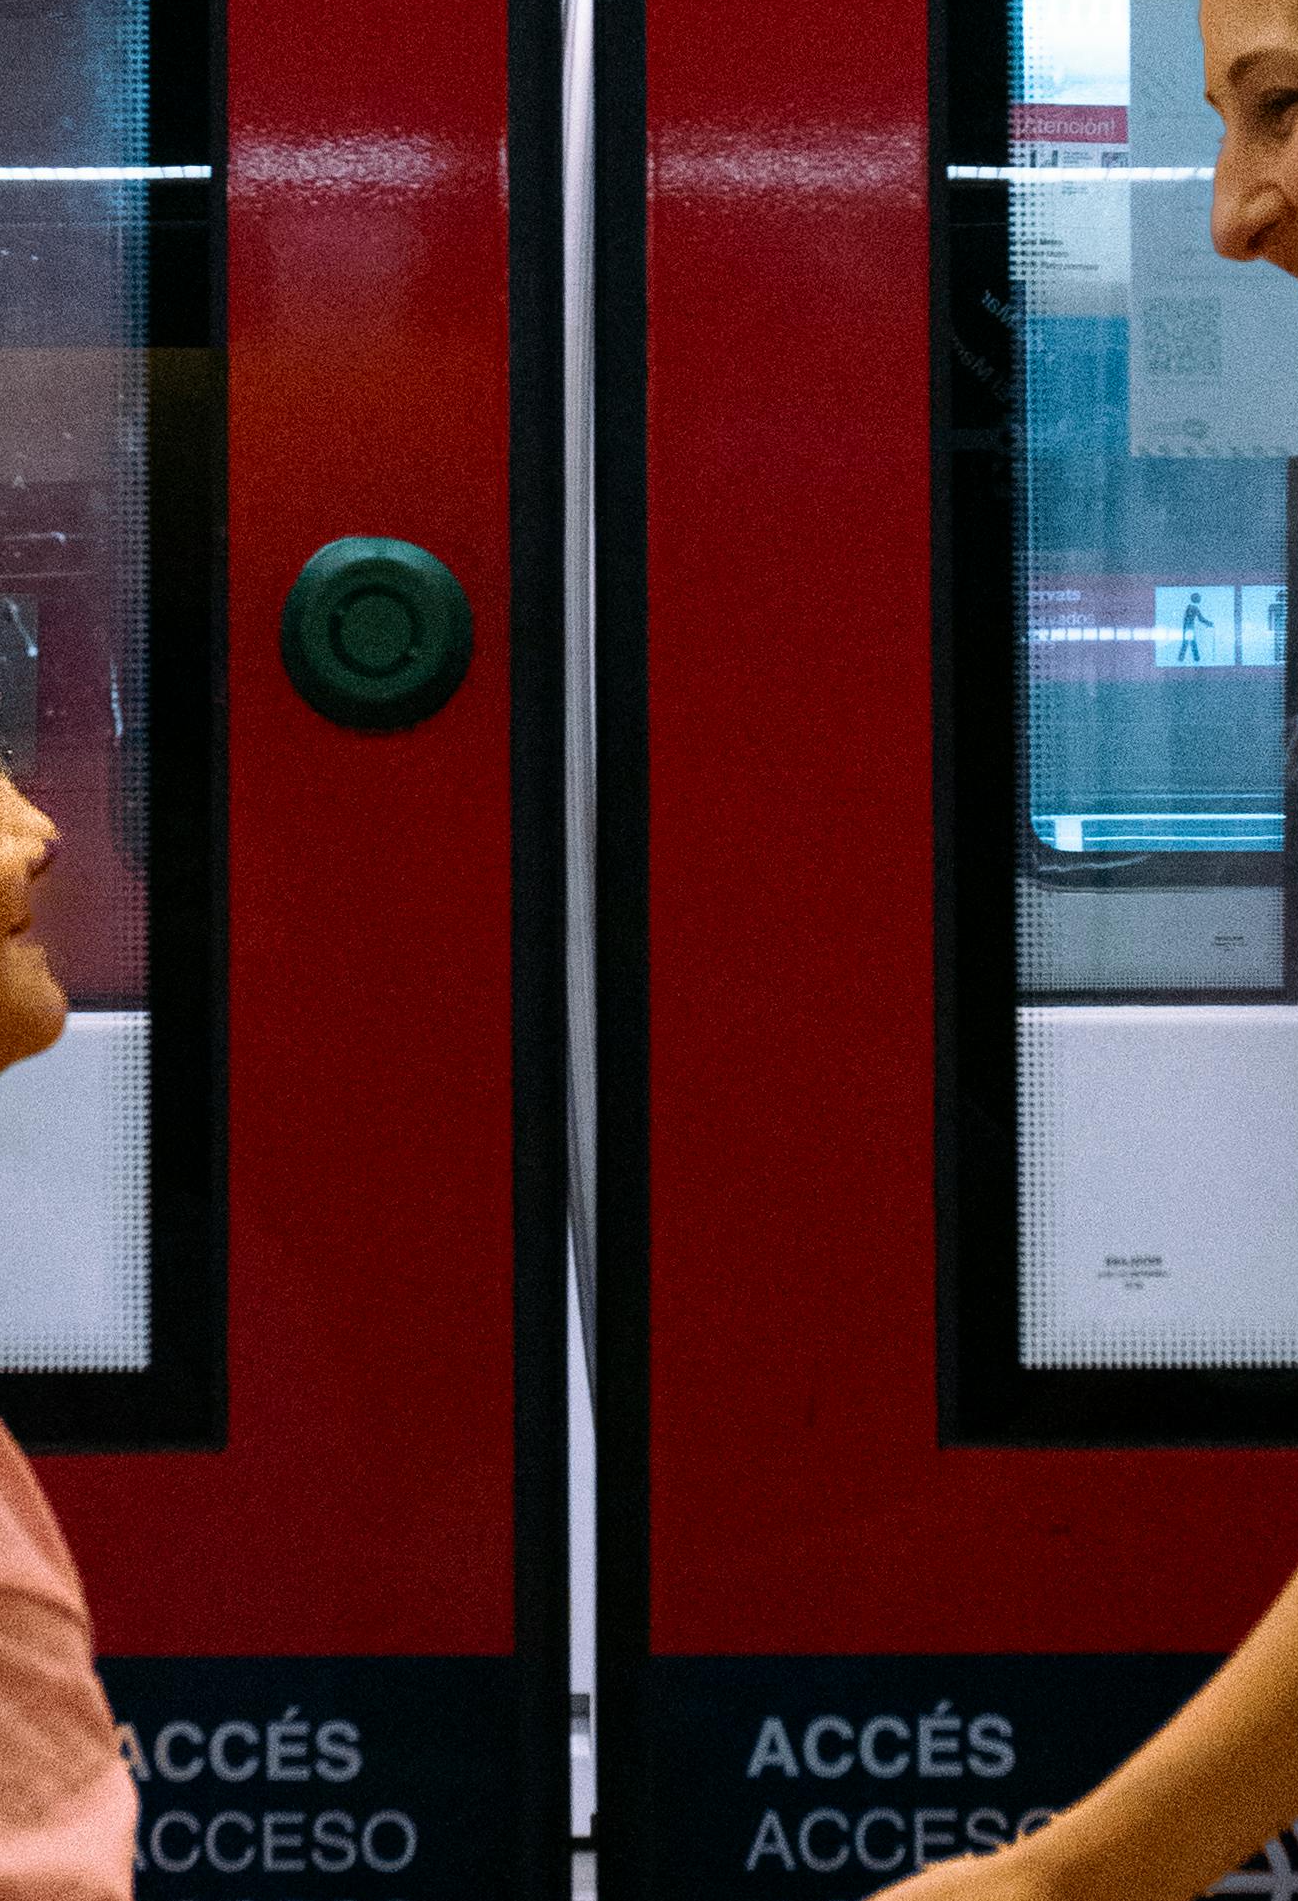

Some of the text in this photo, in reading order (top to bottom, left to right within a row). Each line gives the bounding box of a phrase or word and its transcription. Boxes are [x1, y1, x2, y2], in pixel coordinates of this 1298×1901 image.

[116, 1703, 364, 1782] ACCÉS
[746, 1700, 1016, 1780] ACCÉS
[134, 1809, 418, 1873] CCESO
